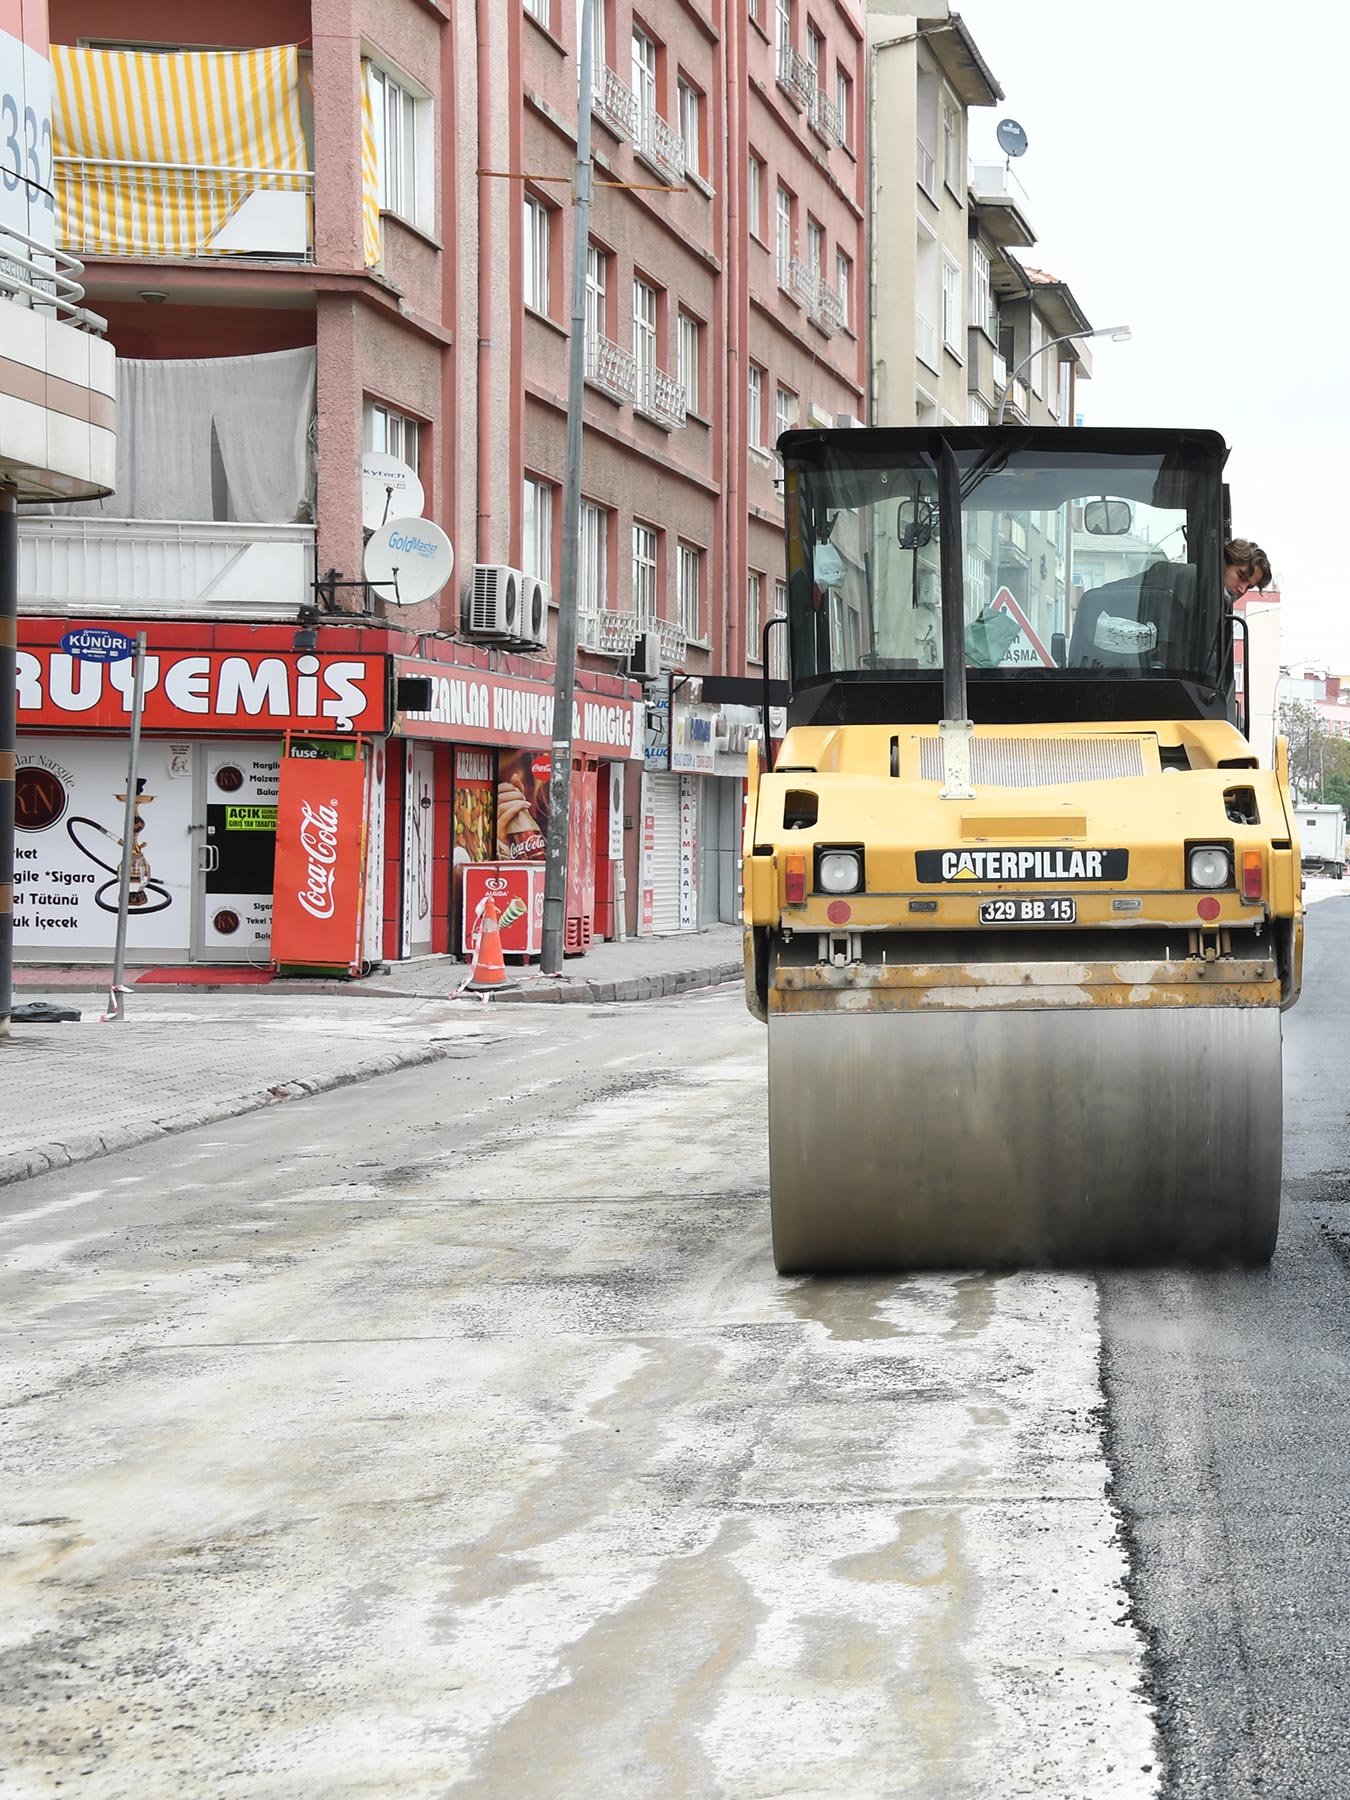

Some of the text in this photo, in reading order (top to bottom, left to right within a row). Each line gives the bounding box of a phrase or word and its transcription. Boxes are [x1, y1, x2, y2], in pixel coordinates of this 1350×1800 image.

[363, 468, 405, 479] kytech
[388, 531, 438, 554] GoldMaster
[69, 633, 127, 650] KÜNÜRİ
[1002, 649, 1038, 664] AŞMA
[493, 686, 555, 736] KURUYEM
[584, 702, 631, 747] NARGİLE
[290, 746, 318, 759] fuse
[15, 754, 76, 789] lar Nargile
[229, 808, 260, 821] AÇIK
[15, 847, 38, 859] ket
[298, 799, 339, 919] Coca-Cola
[941, 850, 1103, 880] CATERPILLAR
[29, 892, 79, 906] Tütünü
[984, 900, 1072, 920] 329 BB 15
[35, 911, 79, 931] İçecek
